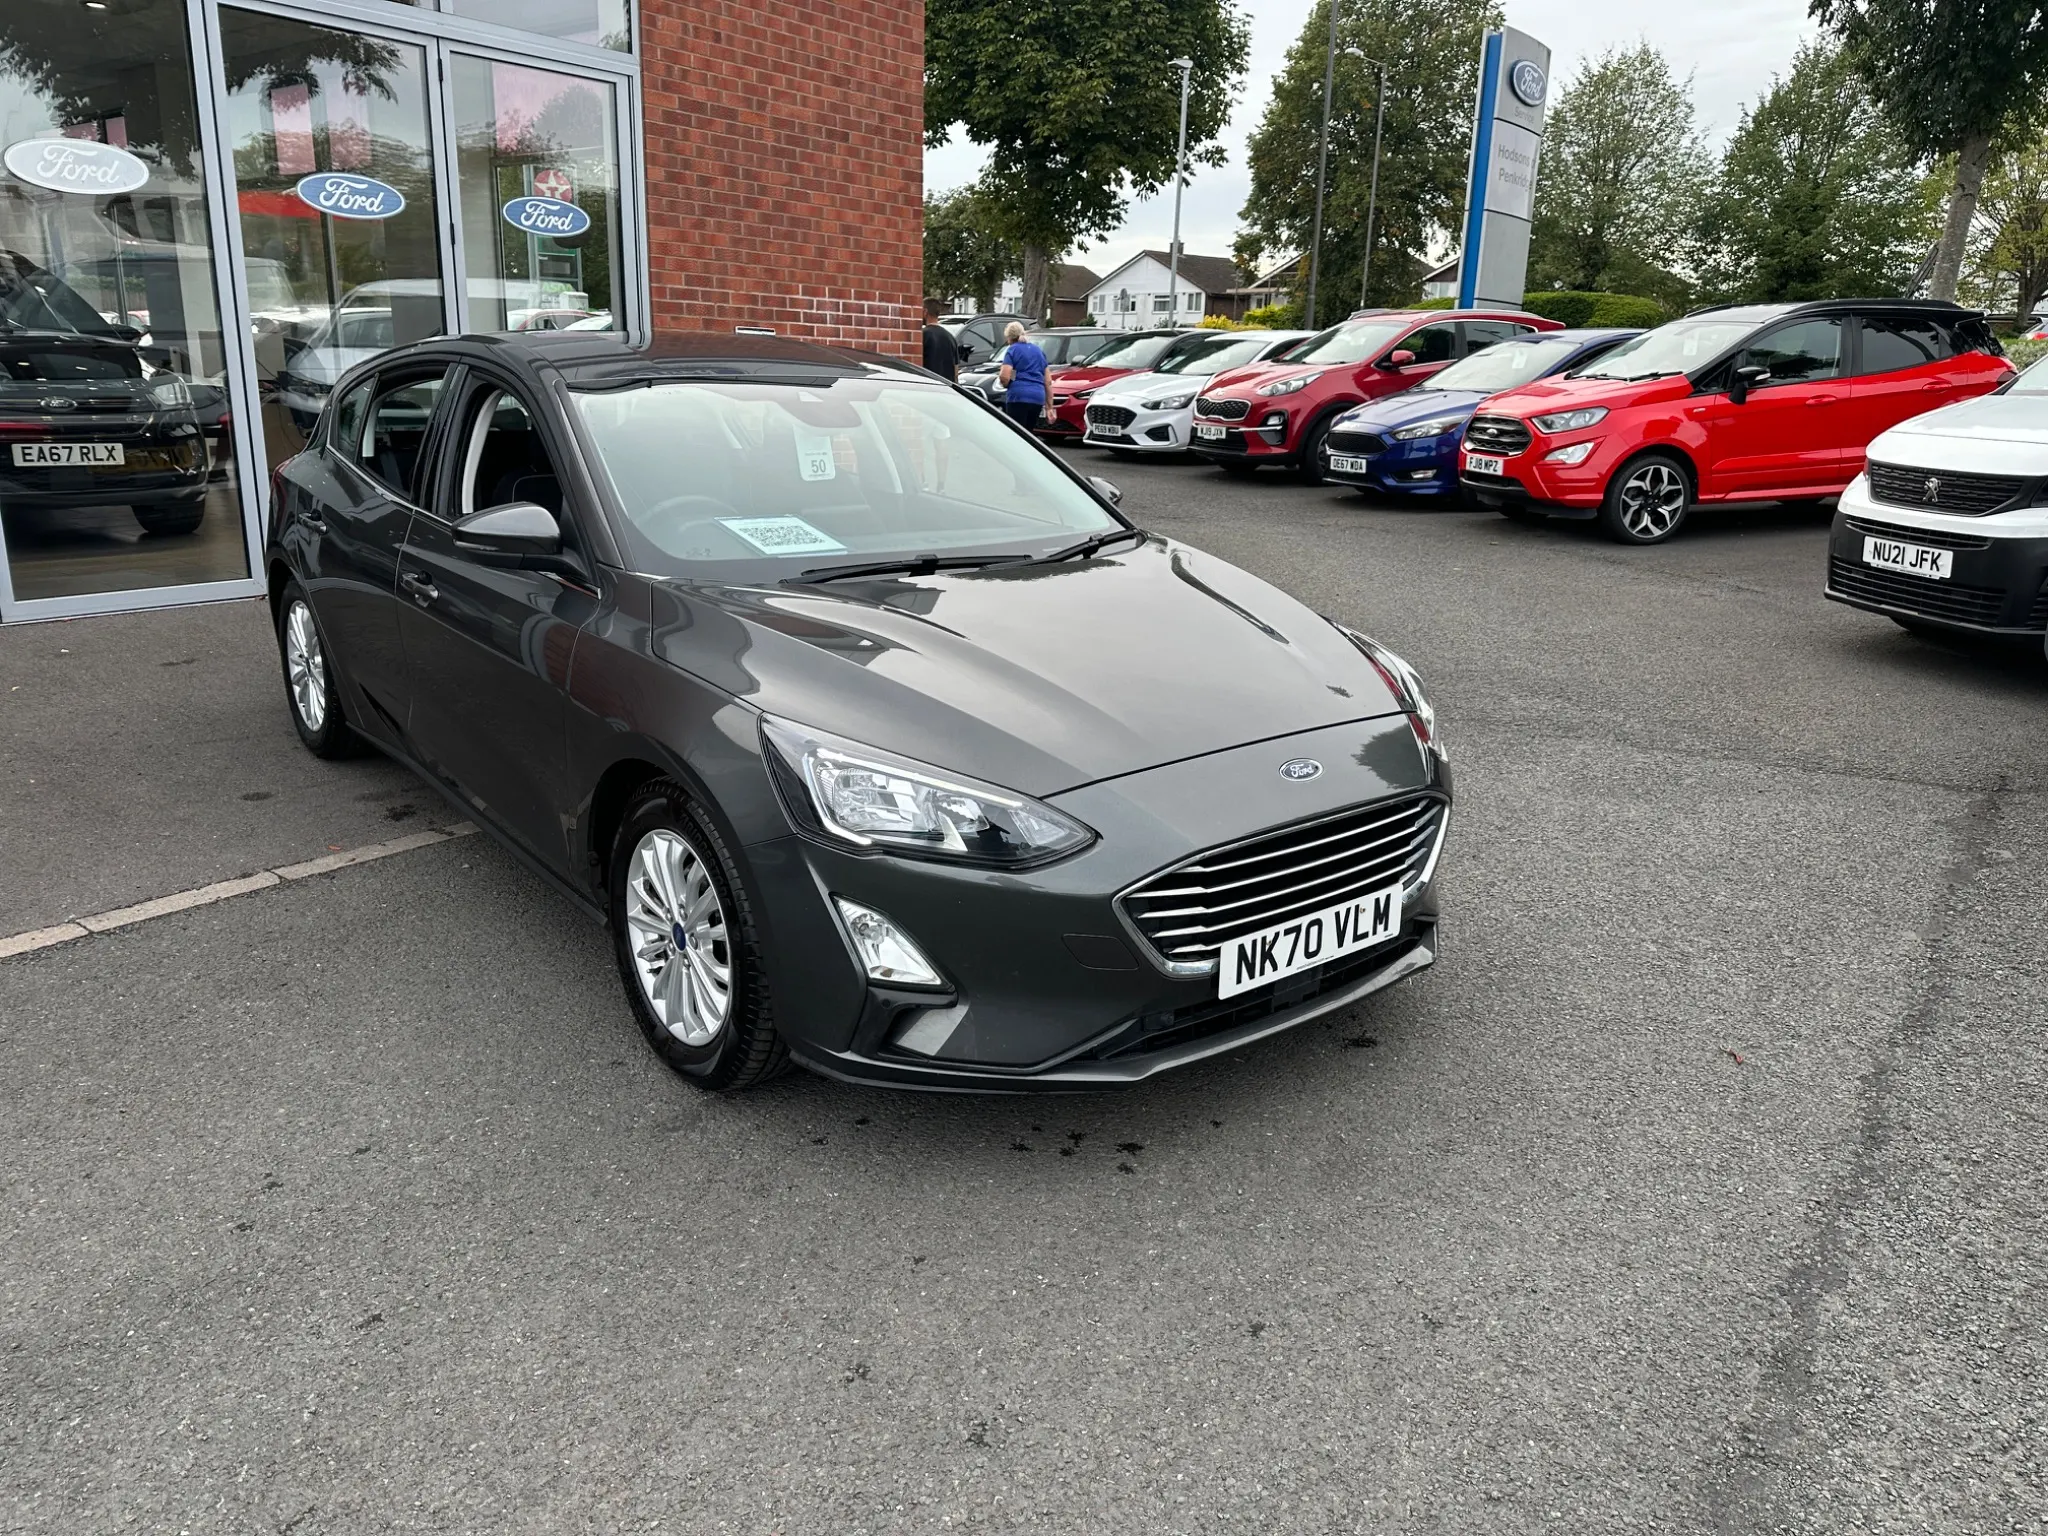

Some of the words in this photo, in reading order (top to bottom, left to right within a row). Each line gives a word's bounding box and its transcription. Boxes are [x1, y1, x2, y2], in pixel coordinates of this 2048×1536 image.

[1521, 67, 1543, 97] Ford
[36, 144, 120, 184] Ford
[1497, 143, 1531, 168] Hodsons
[319, 178, 385, 213] Ford
[520, 200, 574, 231] Ford
[20, 446, 73, 463] EA67
[79, 445, 118, 462] RLX
[811, 459, 826, 473] 50
[1469, 456, 1483, 470] FJ18
[1483, 459, 1499, 473] MPZ
[1872, 541, 1906, 565] NU21
[1908, 549, 1942, 572] JFK
[1290, 763, 1314, 778] Ford
[1235, 917, 1324, 985] NK70
[1334, 893, 1392, 949] VLM
